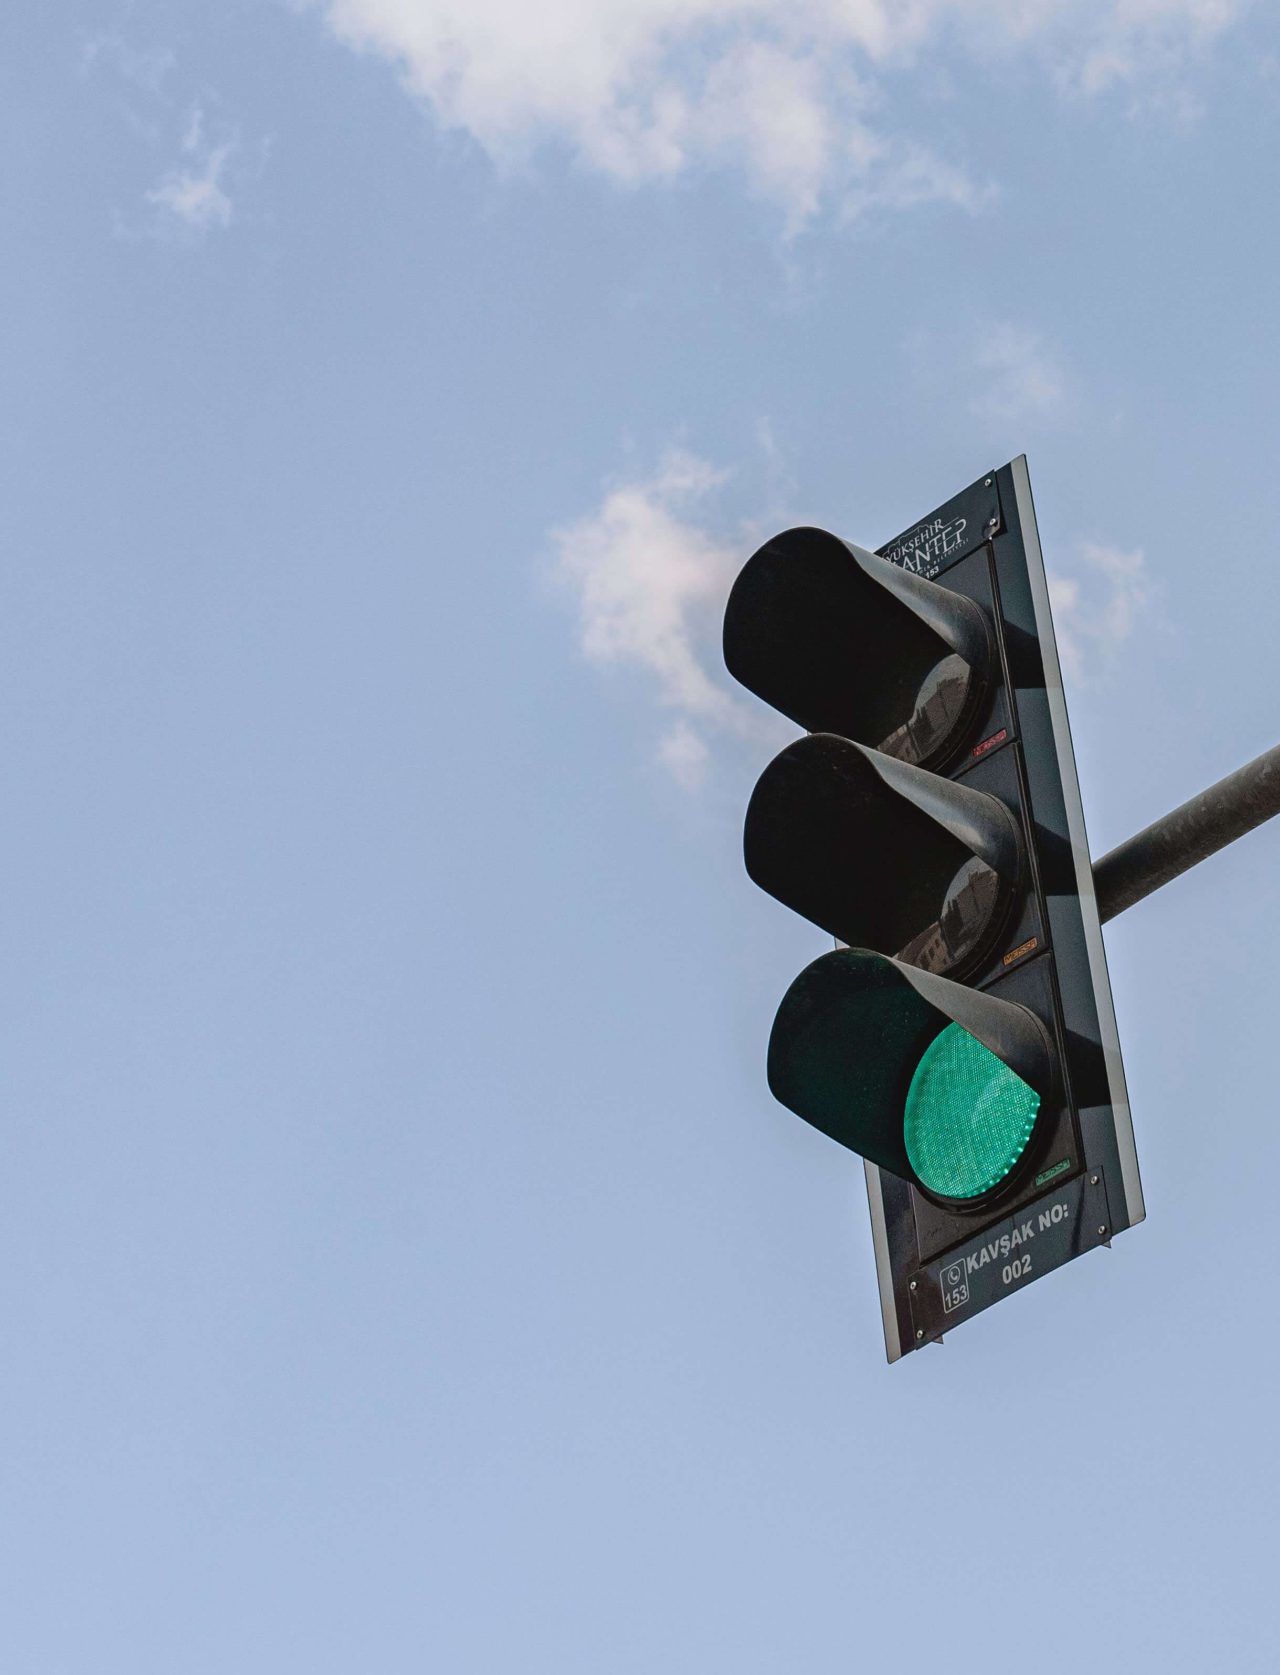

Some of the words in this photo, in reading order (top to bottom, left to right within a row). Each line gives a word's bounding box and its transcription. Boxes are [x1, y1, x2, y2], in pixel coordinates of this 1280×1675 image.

[894, 518, 967, 573] ANTEP
[967, 1220, 1035, 1274] KAVŞAK
[1038, 1204, 1069, 1232] NO:
[1002, 1254, 1032, 1284] 002
[945, 1284, 967, 1308] 153
